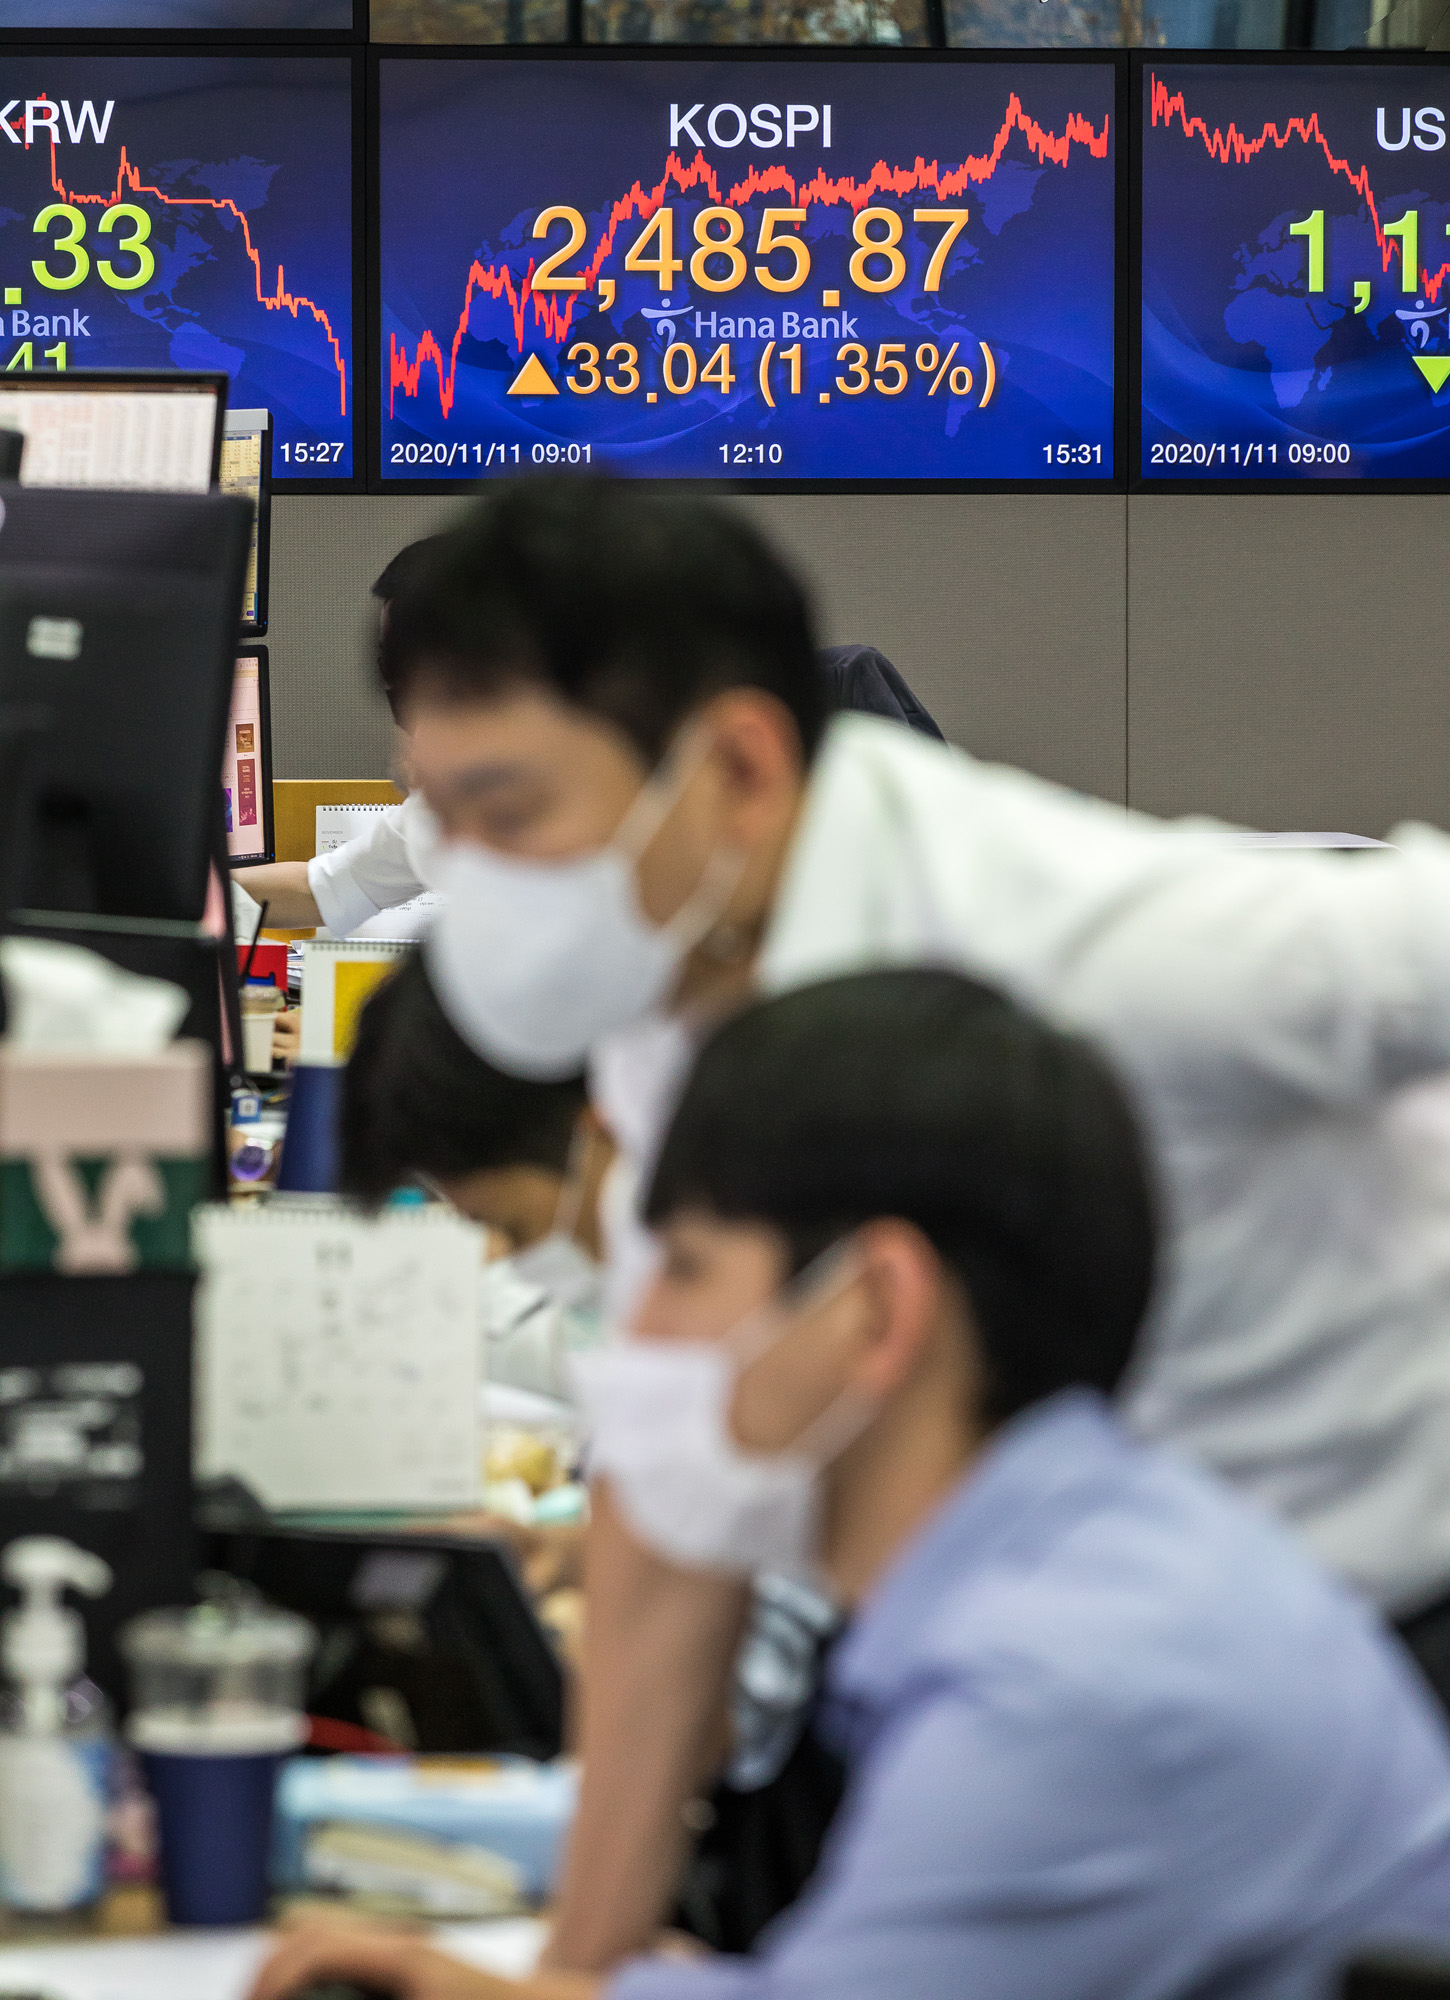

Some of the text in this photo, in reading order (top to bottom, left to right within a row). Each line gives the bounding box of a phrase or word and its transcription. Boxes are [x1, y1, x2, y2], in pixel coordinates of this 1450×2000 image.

[0, 100, 115, 143] KRW
[670, 103, 832, 148] KOSPI
[531, 205, 969, 312] 2,485.87
[1289, 209, 1450, 314] 1,1
[12, 308, 92, 337] Bank
[694, 310, 859, 339] Hana Bank
[566, 341, 997, 408] 33.04 (1.35%)
[280, 442, 344, 463] 15:27
[390, 442, 592, 466] 2020/11/11 09:01
[719, 443, 782, 463] 12:10
[1042, 443, 1102, 464] 15:31
[1150, 443, 1350, 467] 2020/11/11 09:00
